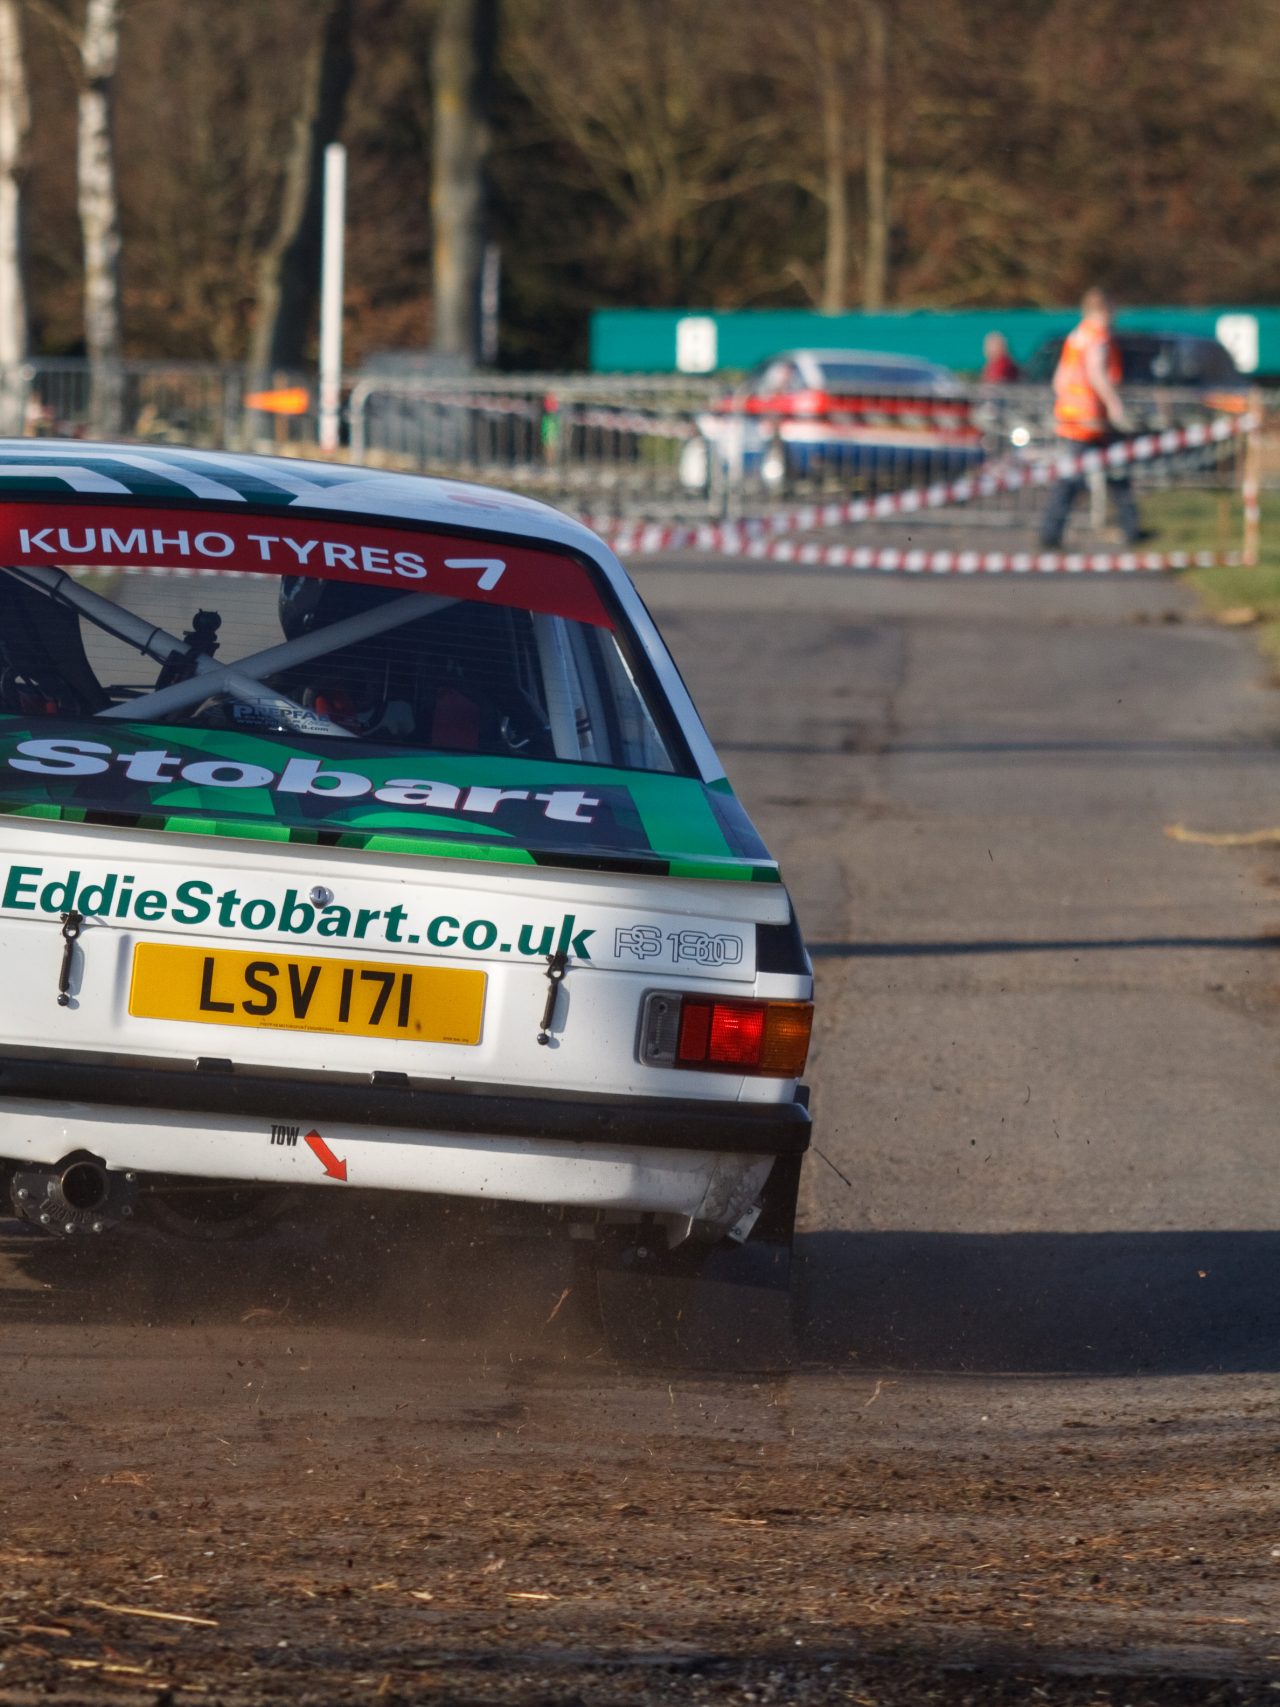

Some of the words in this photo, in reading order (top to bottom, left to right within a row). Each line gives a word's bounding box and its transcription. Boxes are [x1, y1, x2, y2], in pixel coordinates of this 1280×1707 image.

[19, 528, 235, 558] KUMHO
[247, 534, 428, 579] TYRES
[8, 739, 599, 823] Stobart
[1, 865, 596, 960] EddieStobart.co.uk
[199, 957, 322, 1018] LSV
[338, 968, 413, 1028] 171
[270, 1124, 300, 1146] TOW
